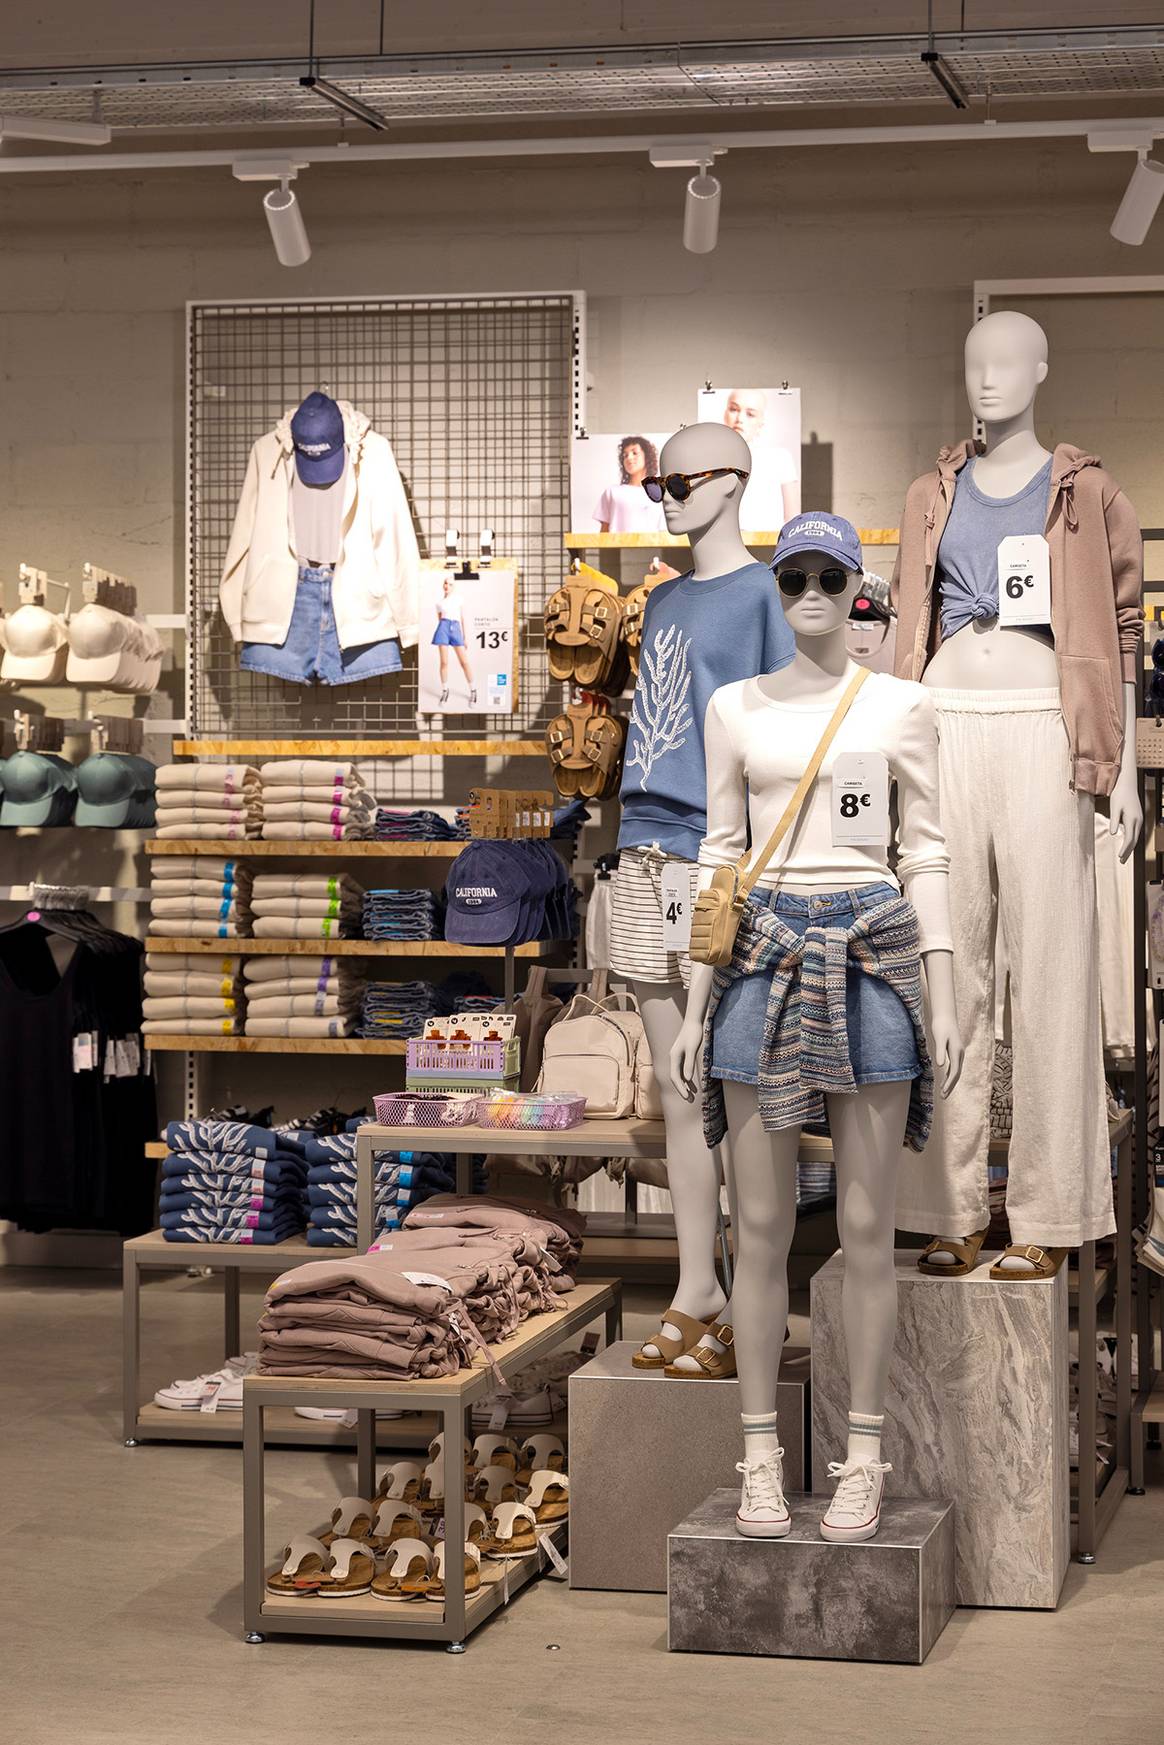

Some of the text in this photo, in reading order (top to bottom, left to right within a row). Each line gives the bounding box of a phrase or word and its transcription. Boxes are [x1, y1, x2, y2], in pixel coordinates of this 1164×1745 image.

[788, 520, 843, 541] CALIFORNIA
[1005, 574, 1035, 599] 6€
[475, 631, 508, 649] 13€
[840, 793, 871, 818] 8€
[455, 887, 498, 898] CALIFORNIA
[666, 902, 683, 925] 4€
